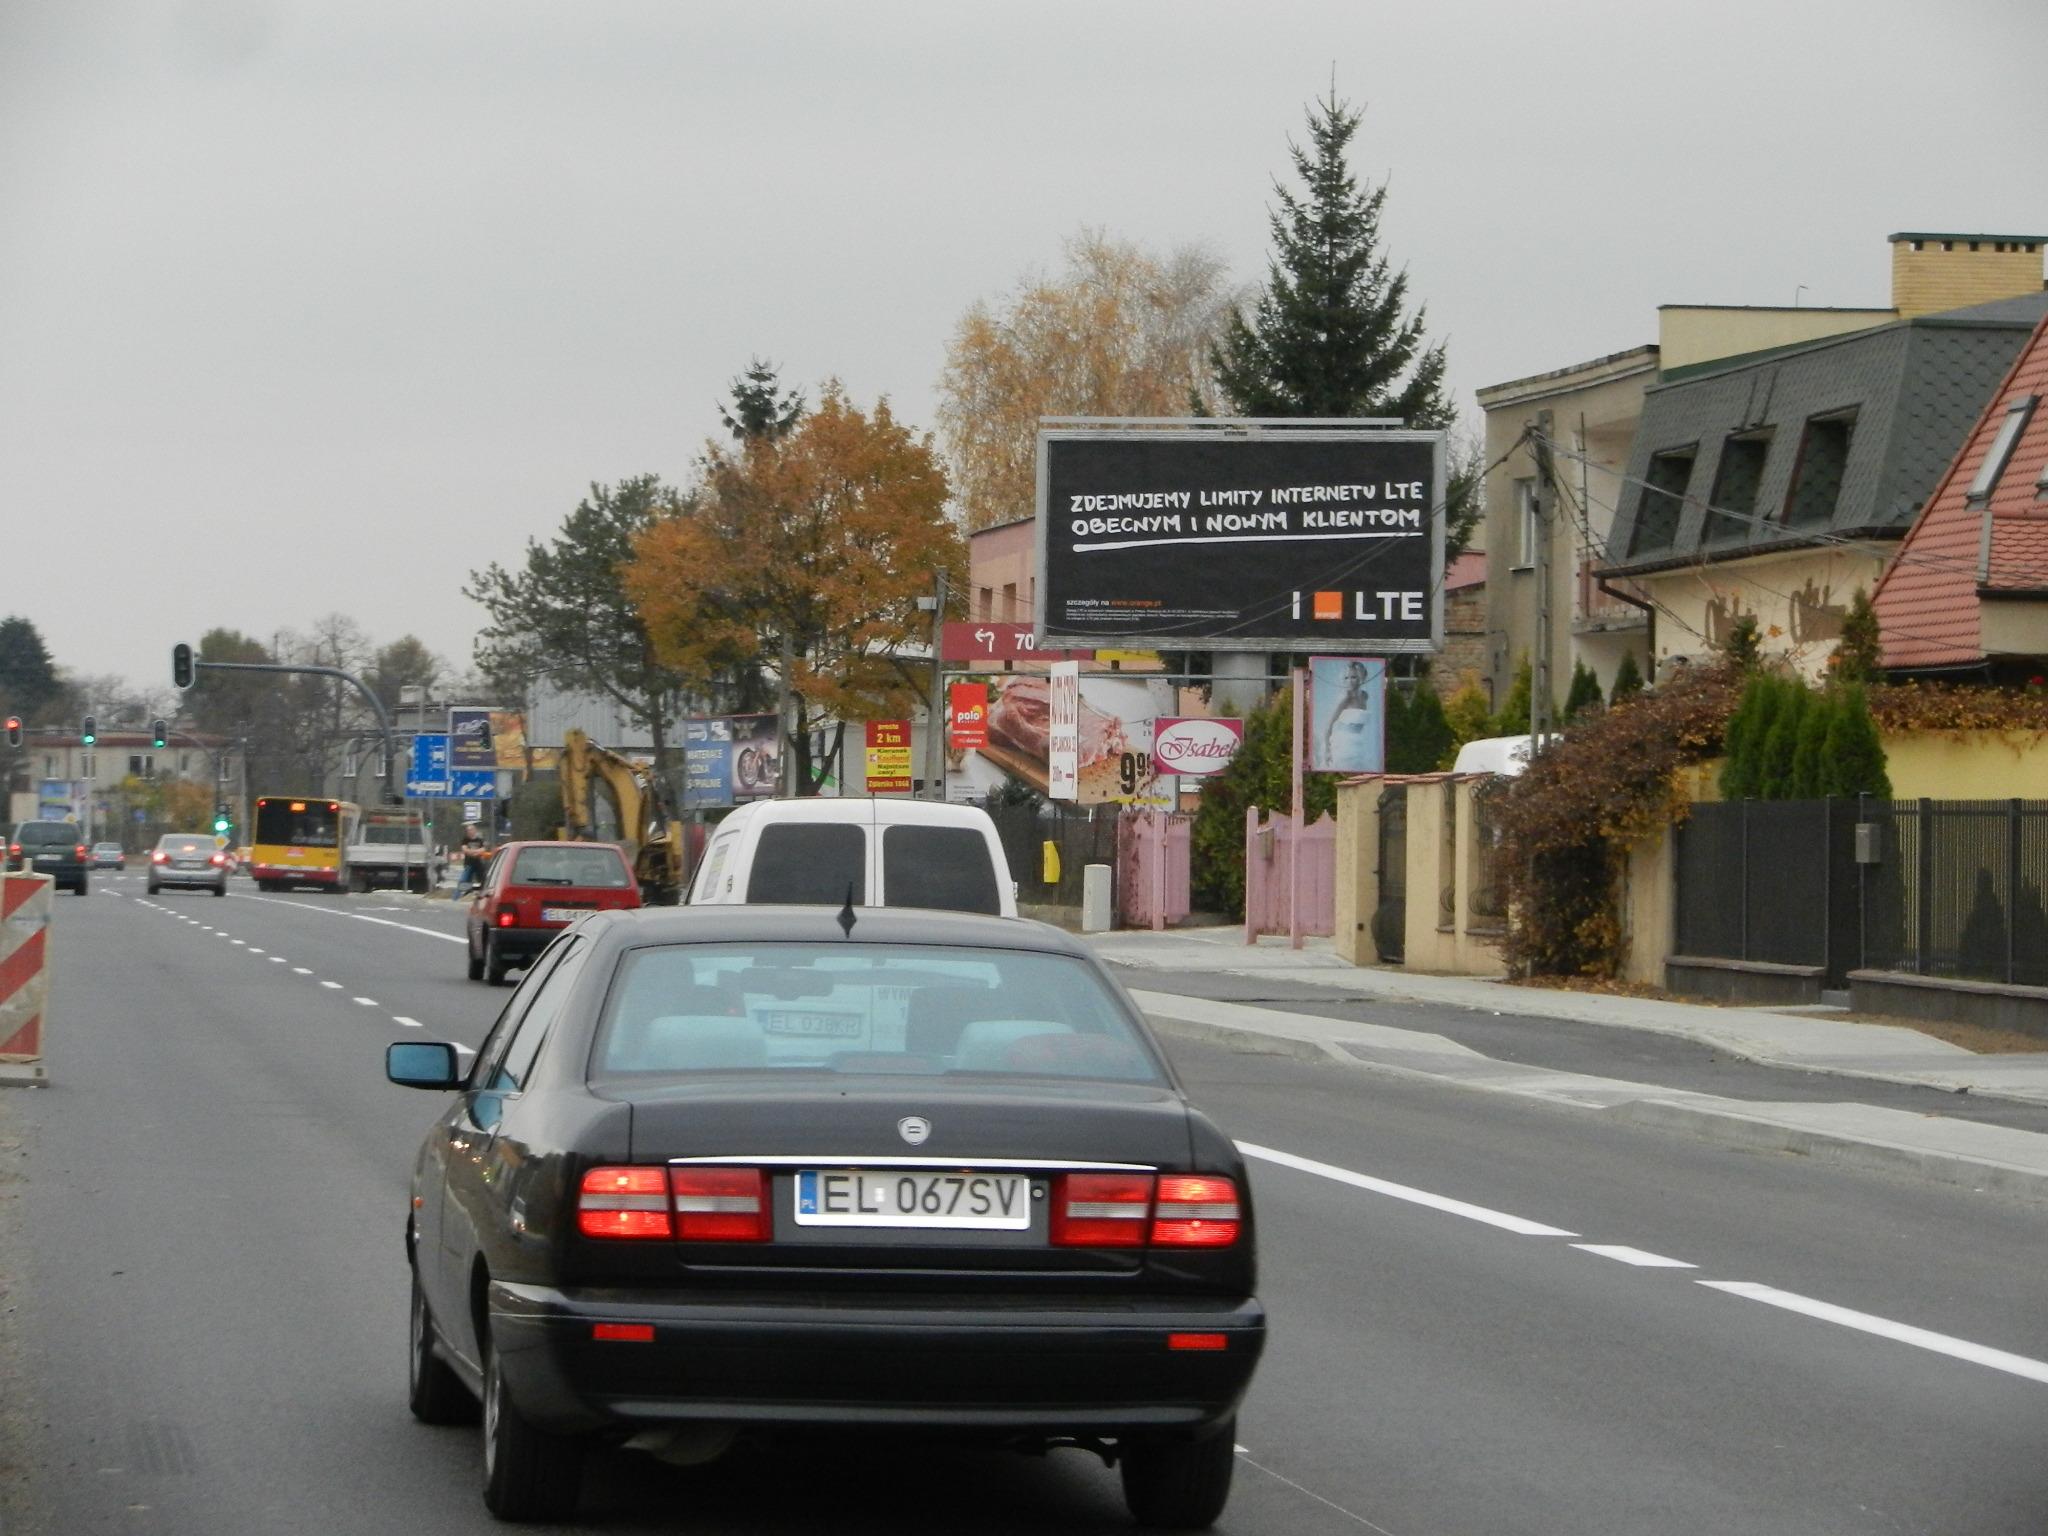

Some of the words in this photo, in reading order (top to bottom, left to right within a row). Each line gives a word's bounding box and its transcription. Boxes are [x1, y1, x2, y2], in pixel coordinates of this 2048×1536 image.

[1070, 491, 1191, 513] ZDEJMUJEMY
[1200, 490, 1262, 506] LIMITY
[1271, 485, 1376, 504] INTERNETU
[1385, 481, 1423, 500] LTE
[1071, 514, 1181, 536] OBECNYM
[1190, 516, 1198, 532] I
[1206, 511, 1288, 532] NOWYM
[1303, 508, 1420, 528] KLIENTOM
[1292, 591, 1300, 620] I
[1355, 591, 1424, 620] LTE
[1014, 633, 1035, 650] 70
[957, 710, 980, 724] polo
[877, 733, 884, 743] 2
[886, 733, 901, 743] km
[1160, 737, 1239, 760] Isabel
[801, 1199, 815, 1209] PL
[824, 1175, 878, 1213] EL
[896, 1177, 1017, 1216] 067SV
